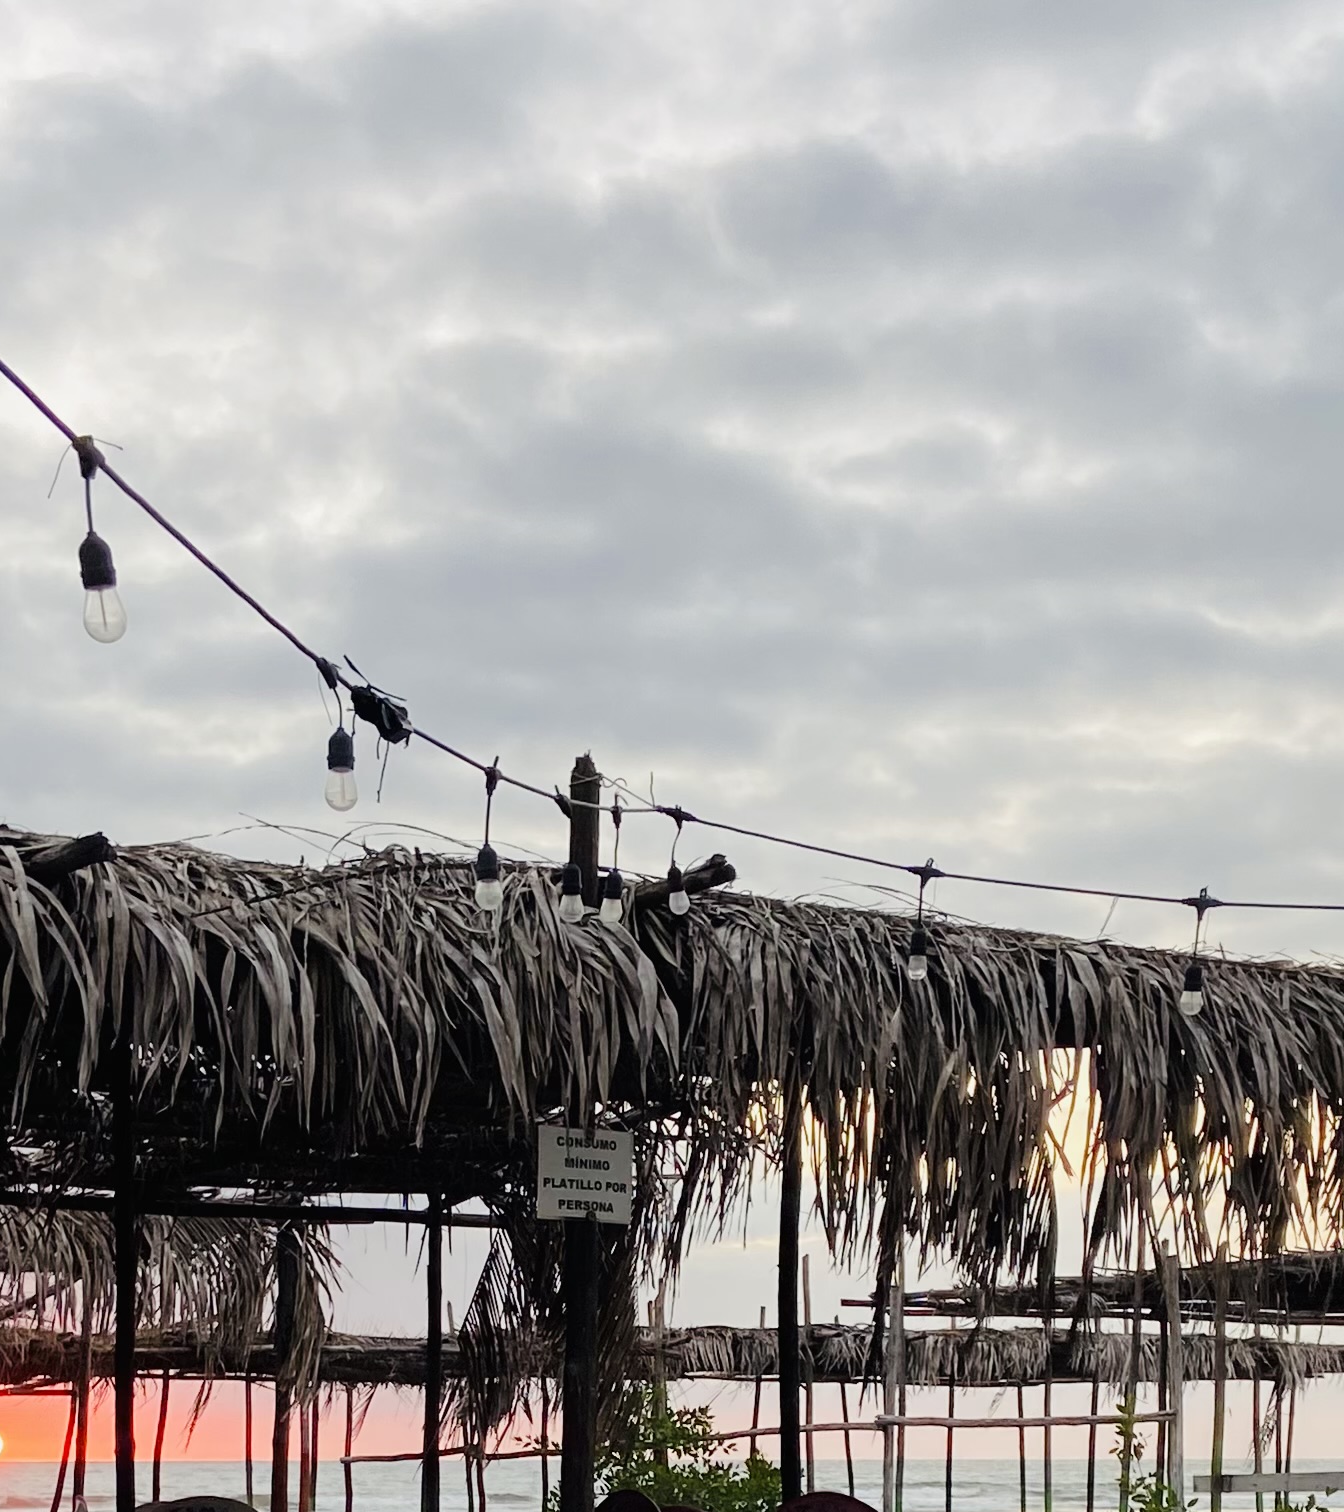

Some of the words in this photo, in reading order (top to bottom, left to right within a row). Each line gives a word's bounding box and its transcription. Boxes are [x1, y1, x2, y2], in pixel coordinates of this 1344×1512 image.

[556, 1136, 617, 1151] CONSUMO
[564, 1156, 610, 1171] MÍNIMO
[543, 1177, 602, 1191] PLATILLO
[605, 1181, 627, 1194] POR
[558, 1199, 614, 1213] PERSONA
